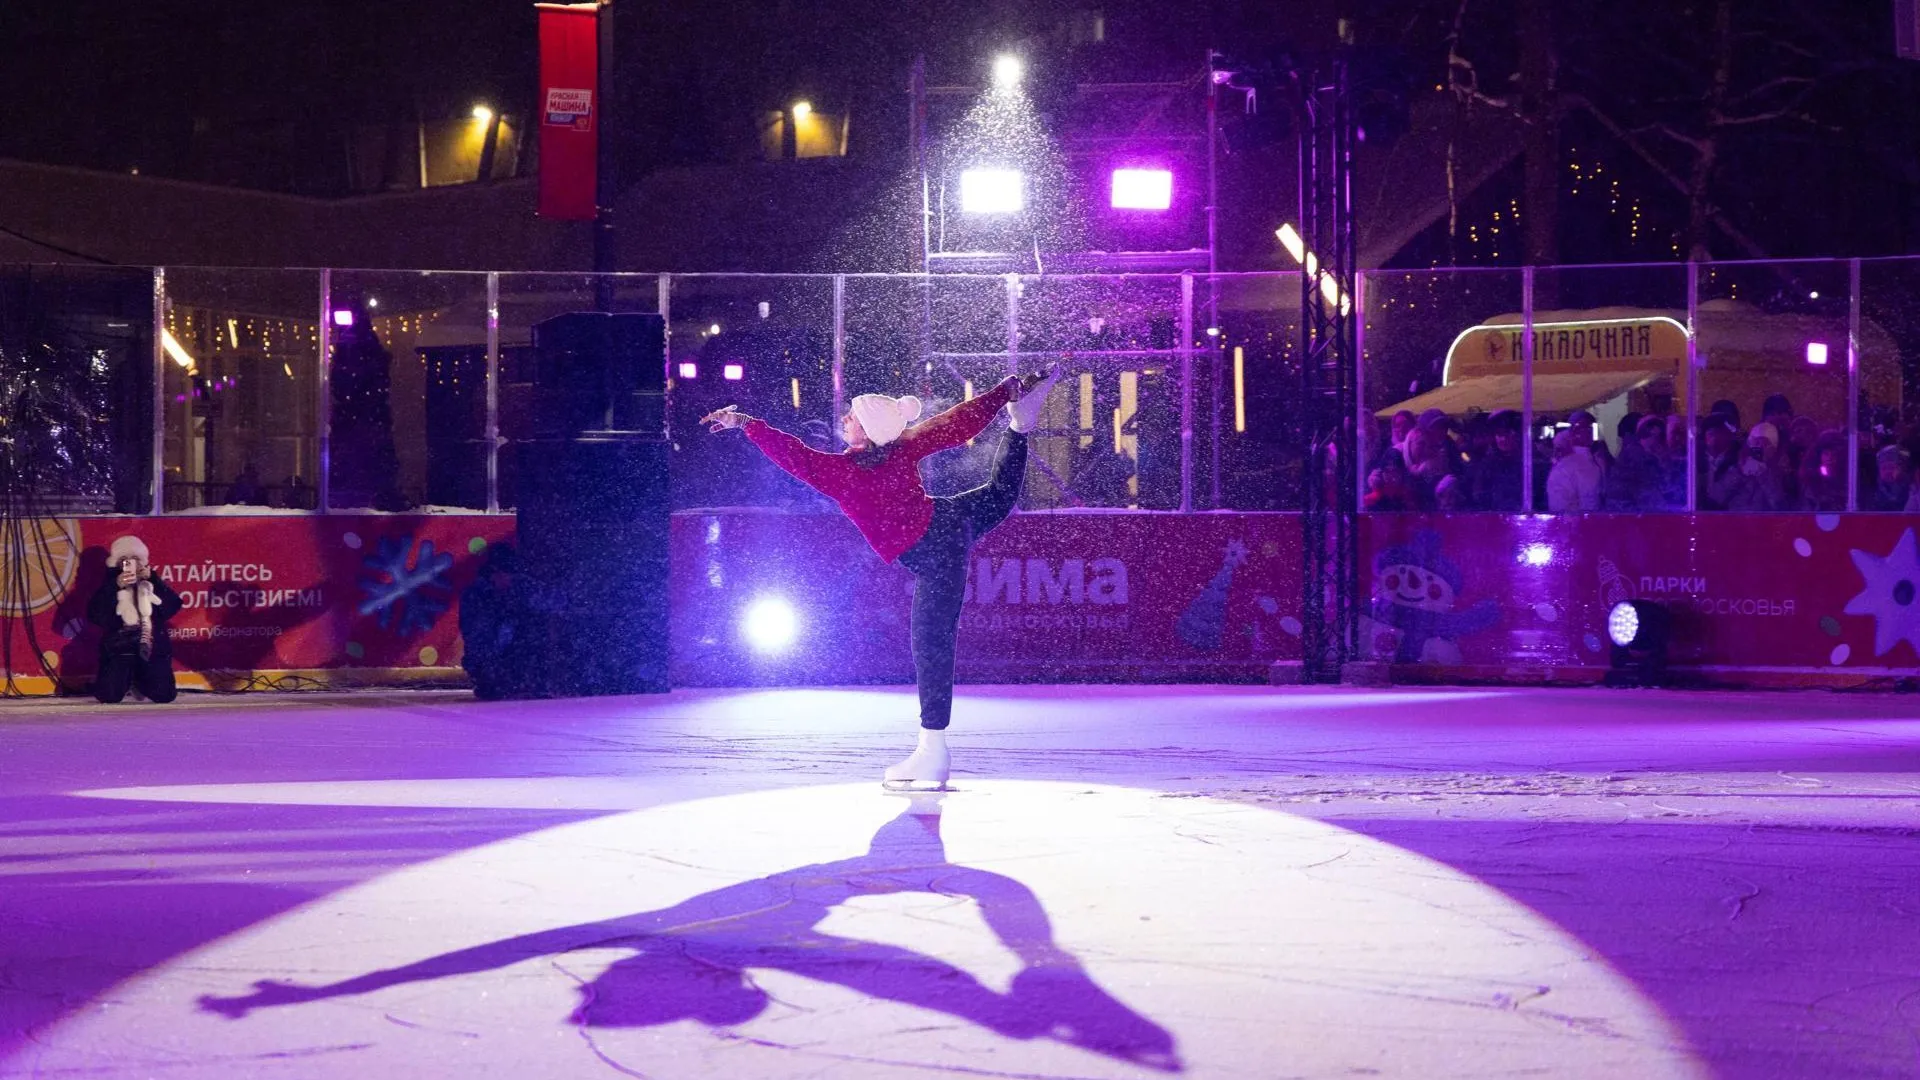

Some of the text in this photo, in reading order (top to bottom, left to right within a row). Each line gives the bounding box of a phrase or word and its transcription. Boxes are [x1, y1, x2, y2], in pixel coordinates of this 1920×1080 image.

[549, 101, 587, 112] МАШИНА
[965, 557, 1129, 604] има
[1640, 576, 1707, 593] ПАРКИ
[179, 589, 323, 609] ОЛЬСТВИЕМ!
[167, 625, 283, 641] анда губернатора
